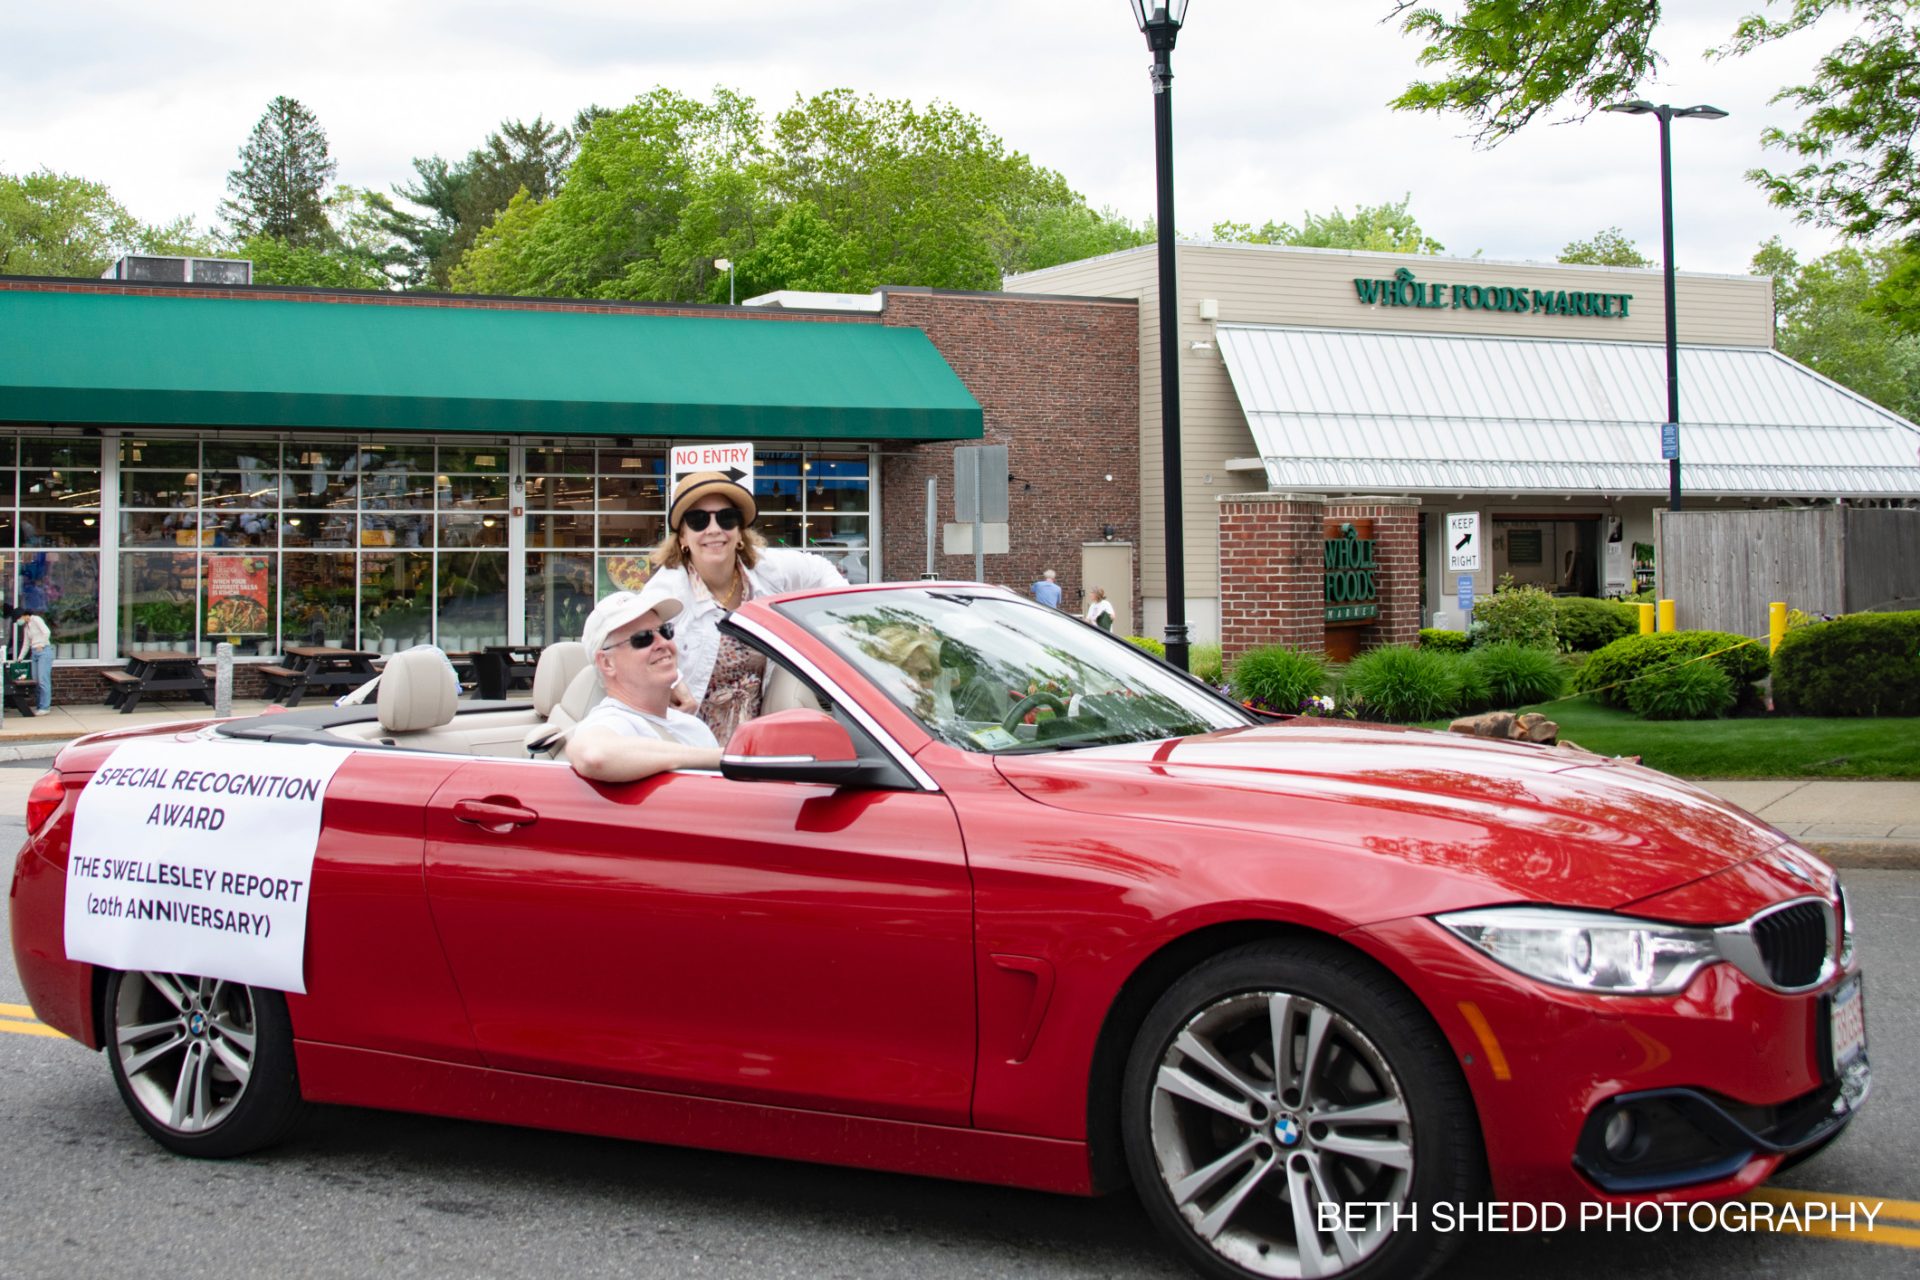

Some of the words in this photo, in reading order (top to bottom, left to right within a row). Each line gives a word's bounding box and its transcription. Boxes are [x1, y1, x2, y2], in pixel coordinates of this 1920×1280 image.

[1354, 277, 1448, 309] WHOLE
[1452, 284, 1530, 312] FOODS
[1532, 289, 1633, 318] MARKET
[676, 450, 698, 465] NO
[703, 447, 749, 464] ENTRY
[1452, 518, 1474, 530] KEEP
[1324, 539, 1377, 569] WHOLE
[1451, 555, 1477, 567] RIGHT
[1324, 570, 1376, 603] FOODS
[1328, 606, 1375, 619] MARKET
[96, 767, 168, 788] SPECIAL
[172, 770, 322, 801] RECOGNITION
[146, 803, 225, 831] AWARD
[73, 856, 101, 878] THE
[102, 858, 217, 891] SWELLESLEY
[221, 871, 303, 902] REPORT
[87, 892, 122, 917] (20th
[126, 898, 271, 938] ANNIVERSARY)
